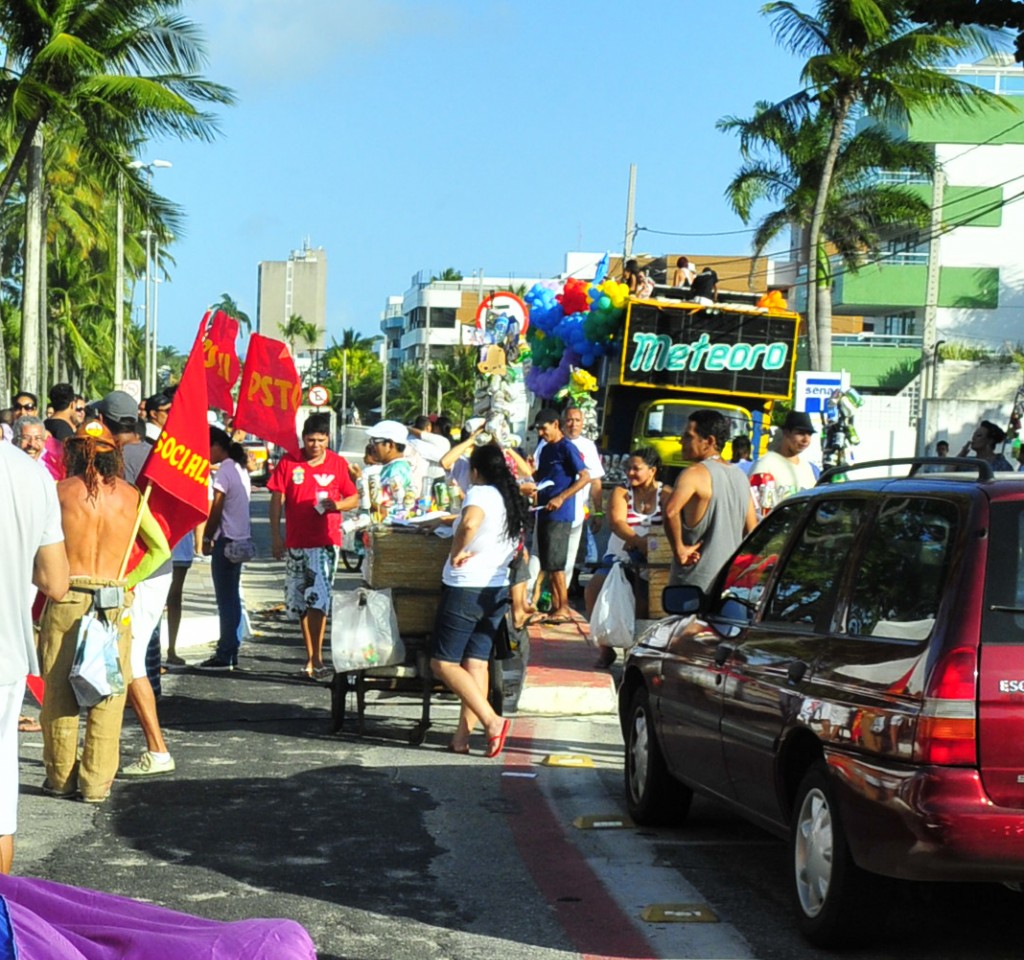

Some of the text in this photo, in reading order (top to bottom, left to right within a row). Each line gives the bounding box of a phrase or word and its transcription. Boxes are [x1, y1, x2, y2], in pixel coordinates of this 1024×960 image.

[630, 332, 788, 371] Meteoro
[805, 386, 838, 395] sena
[153, 430, 210, 486] SOCIAL
